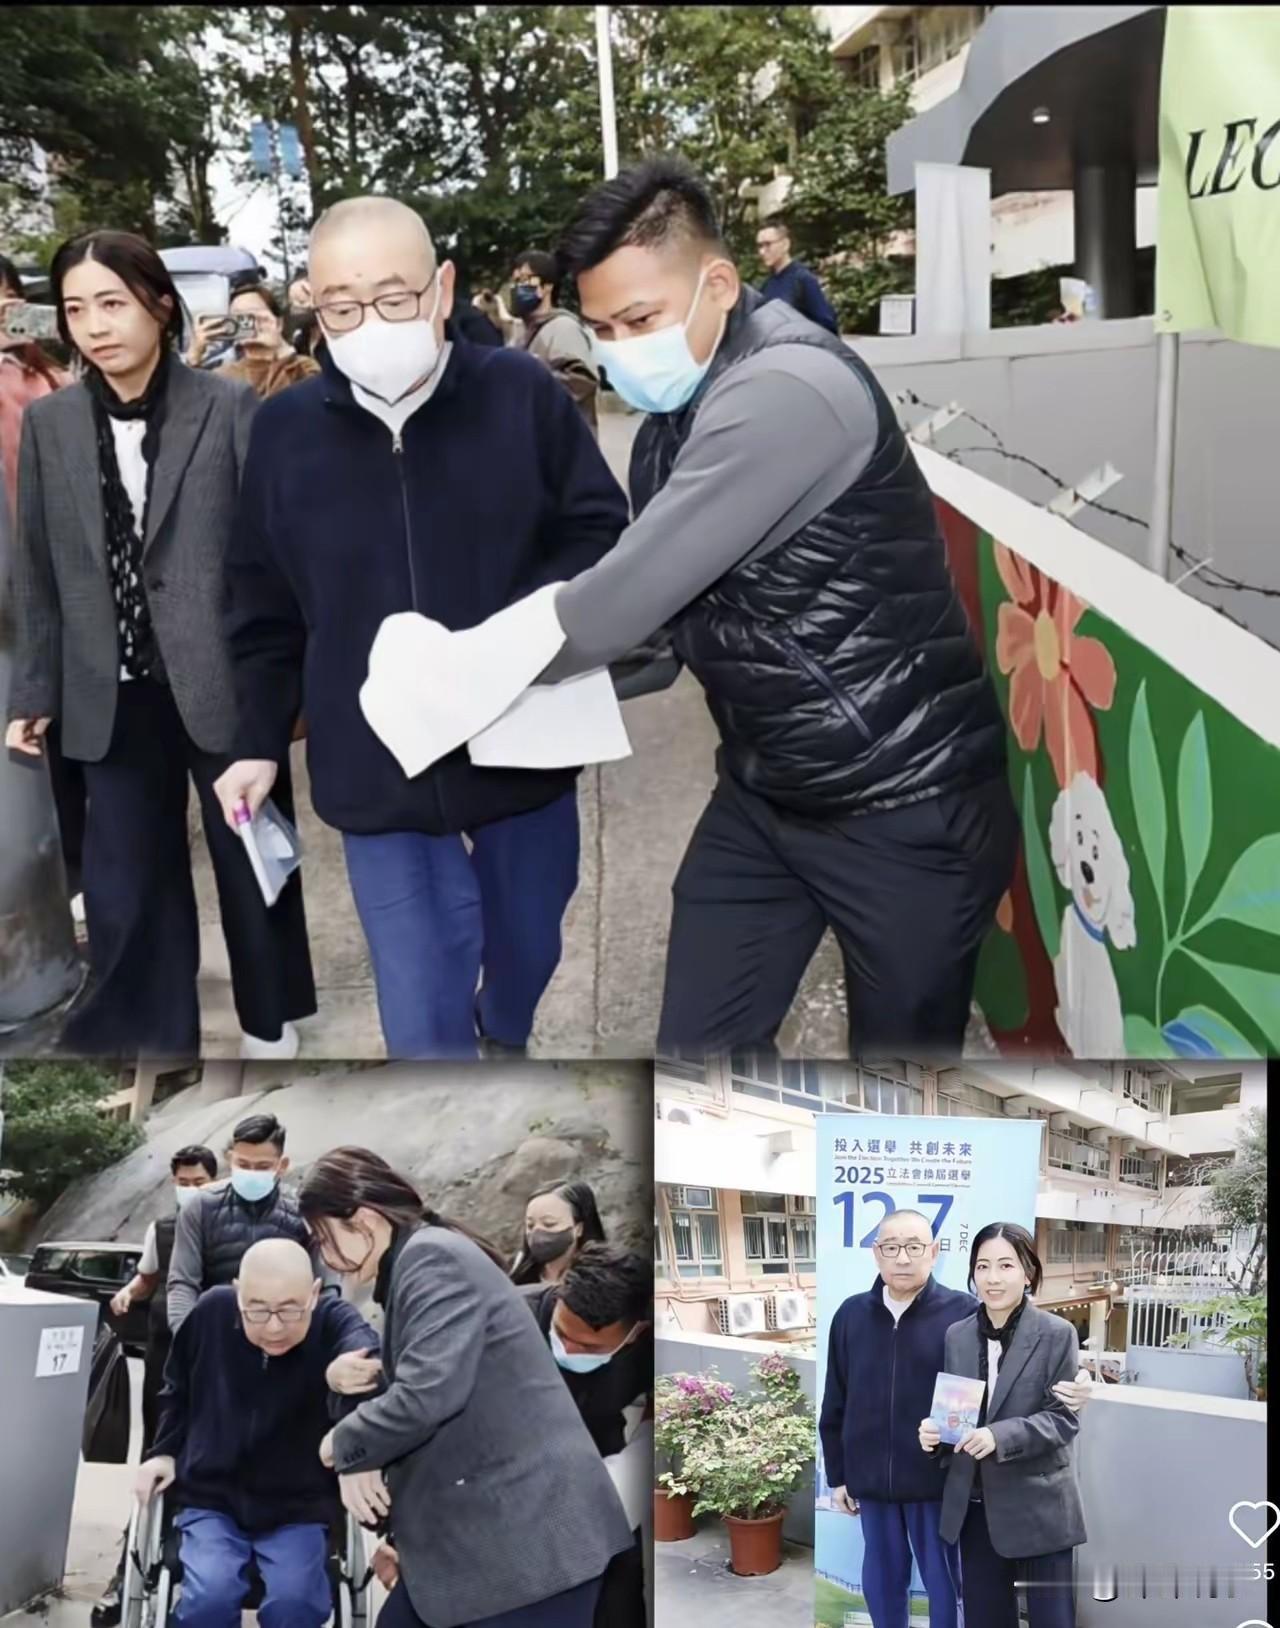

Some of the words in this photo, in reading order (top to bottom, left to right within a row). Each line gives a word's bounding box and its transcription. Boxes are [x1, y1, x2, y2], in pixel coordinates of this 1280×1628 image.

[834, 1138, 897, 1154] 投入選舉
[909, 1140, 972, 1157] 共創未來
[834, 1166, 884, 1184] 2025
[917, 1194, 954, 1241] 7
[940, 1238, 950, 1252] 日
[959, 1231, 969, 1252] DEC
